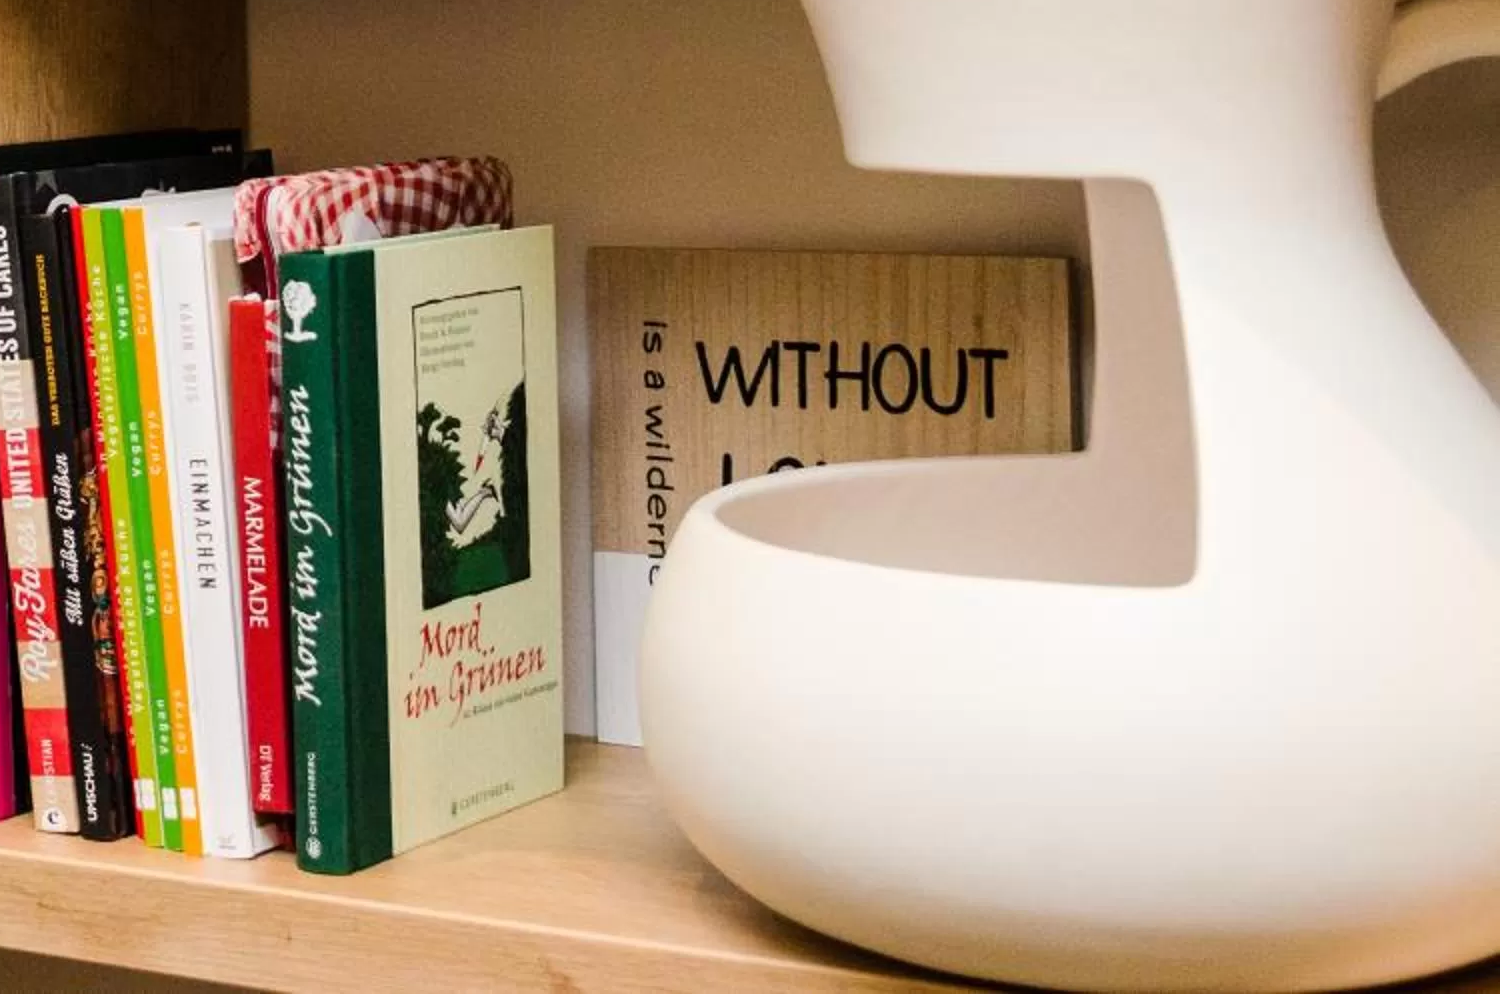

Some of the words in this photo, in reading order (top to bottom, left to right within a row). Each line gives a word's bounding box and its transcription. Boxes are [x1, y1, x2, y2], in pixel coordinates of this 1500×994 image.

[35, 254, 49, 313] BACKBUCH
[115, 284, 129, 340] Vegan
[133, 270, 148, 335] Currys
[41, 314, 53, 343] GUTE
[642, 320, 668, 354] is
[44, 345, 59, 402] VERBOTEN
[98, 331, 120, 458] Vegetarische
[643, 369, 666, 390] a
[695, 339, 1009, 420] WITHOUT
[49, 404, 61, 427] DAS
[148, 409, 163, 475] Currys
[3, 428, 35, 509] UNITED
[129, 421, 142, 477] Vegan
[286, 385, 333, 538] Grünen
[50, 451, 79, 521] Grüßen
[59, 526, 81, 584] süßen
[188, 457, 217, 590] EINMACHEN
[243, 476, 269, 629] MARMELADE
[12, 518, 48, 613] Fares
[142, 559, 156, 617] Vegan
[160, 549, 174, 616] Currys
[297, 545, 318, 597] im
[64, 587, 85, 627] Mit
[417, 602, 483, 669] Mord
[20, 614, 59, 684] Roy
[124, 585, 145, 714] Vegetarische
[289, 607, 322, 707] Mord
[402, 671, 441, 720] im
[441, 645, 547, 730] Grünen
[156, 698, 170, 755] Vegan
[174, 689, 189, 755] Currys
[85, 751, 97, 823] UMSCHAU
[307, 752, 318, 837] GERSTENBERG
